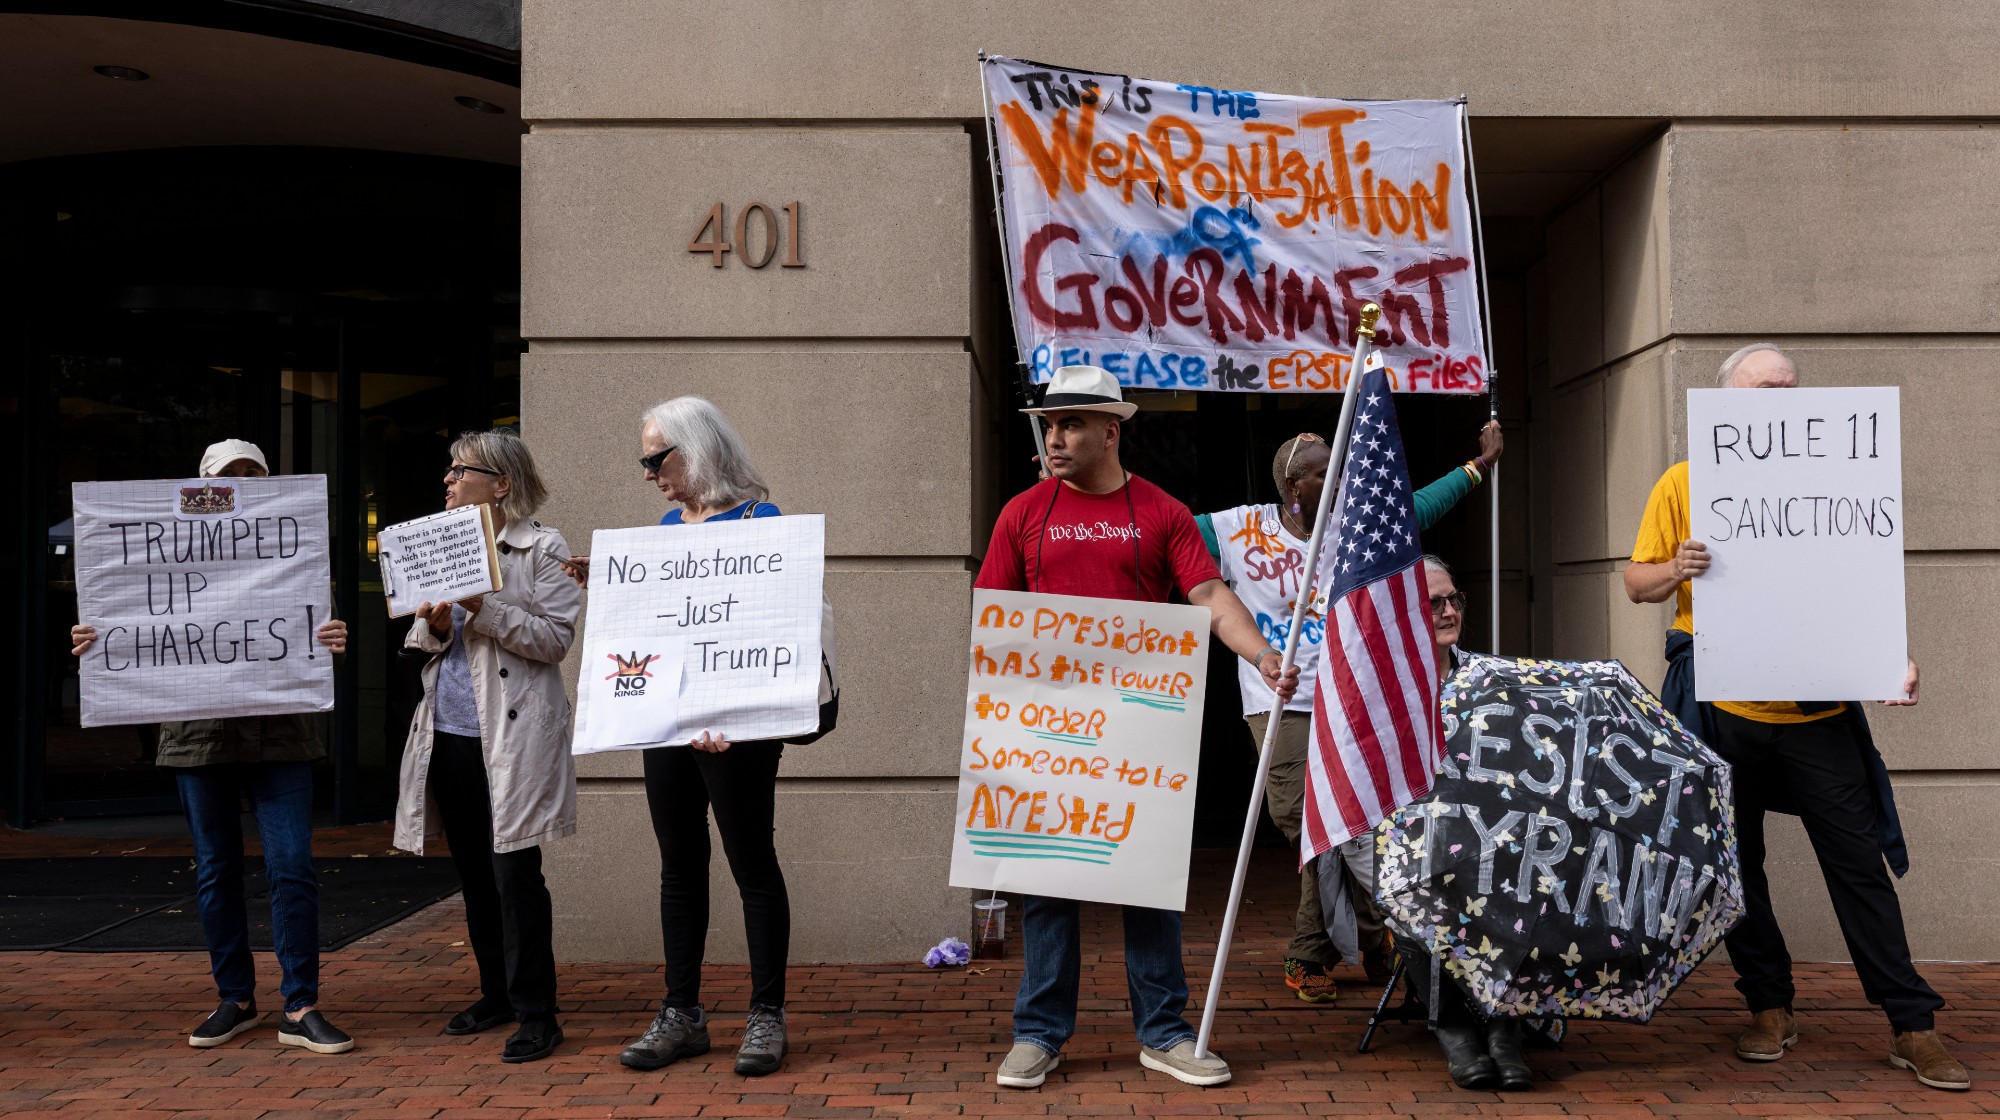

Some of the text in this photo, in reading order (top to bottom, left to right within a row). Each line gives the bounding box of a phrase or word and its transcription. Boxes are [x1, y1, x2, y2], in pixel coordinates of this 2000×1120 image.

[1011, 72, 1261, 120] This is THE
[687, 200, 806, 269] 401
[1212, 354, 1263, 390] the
[1713, 412, 1878, 464] RULE 11
[397, 532, 420, 543] There
[423, 529, 429, 537] is
[444, 518, 474, 532] greater
[1093, 521, 1142, 543] People
[1710, 496, 1895, 542] SANCTIONS
[108, 516, 299, 565] TRUMPED
[394, 536, 478, 564] which is perpetrated
[404, 527, 476, 553] tyranny than that
[404, 545, 481, 572] under the shield of
[407, 573, 420, 582] the
[422, 570, 438, 578] law
[441, 562, 456, 573] and
[469, 557, 481, 565] the
[607, 548, 783, 584] No substance
[148, 571, 207, 615] UP
[420, 567, 482, 589] name of justice.
[693, 641, 791, 677] Trump
[614, 689, 645, 698] KINGS
[615, 677, 647, 690] NO
[974, 693, 1010, 720] to
[1114, 758, 1148, 786] to
[1154, 765, 1188, 792] be
